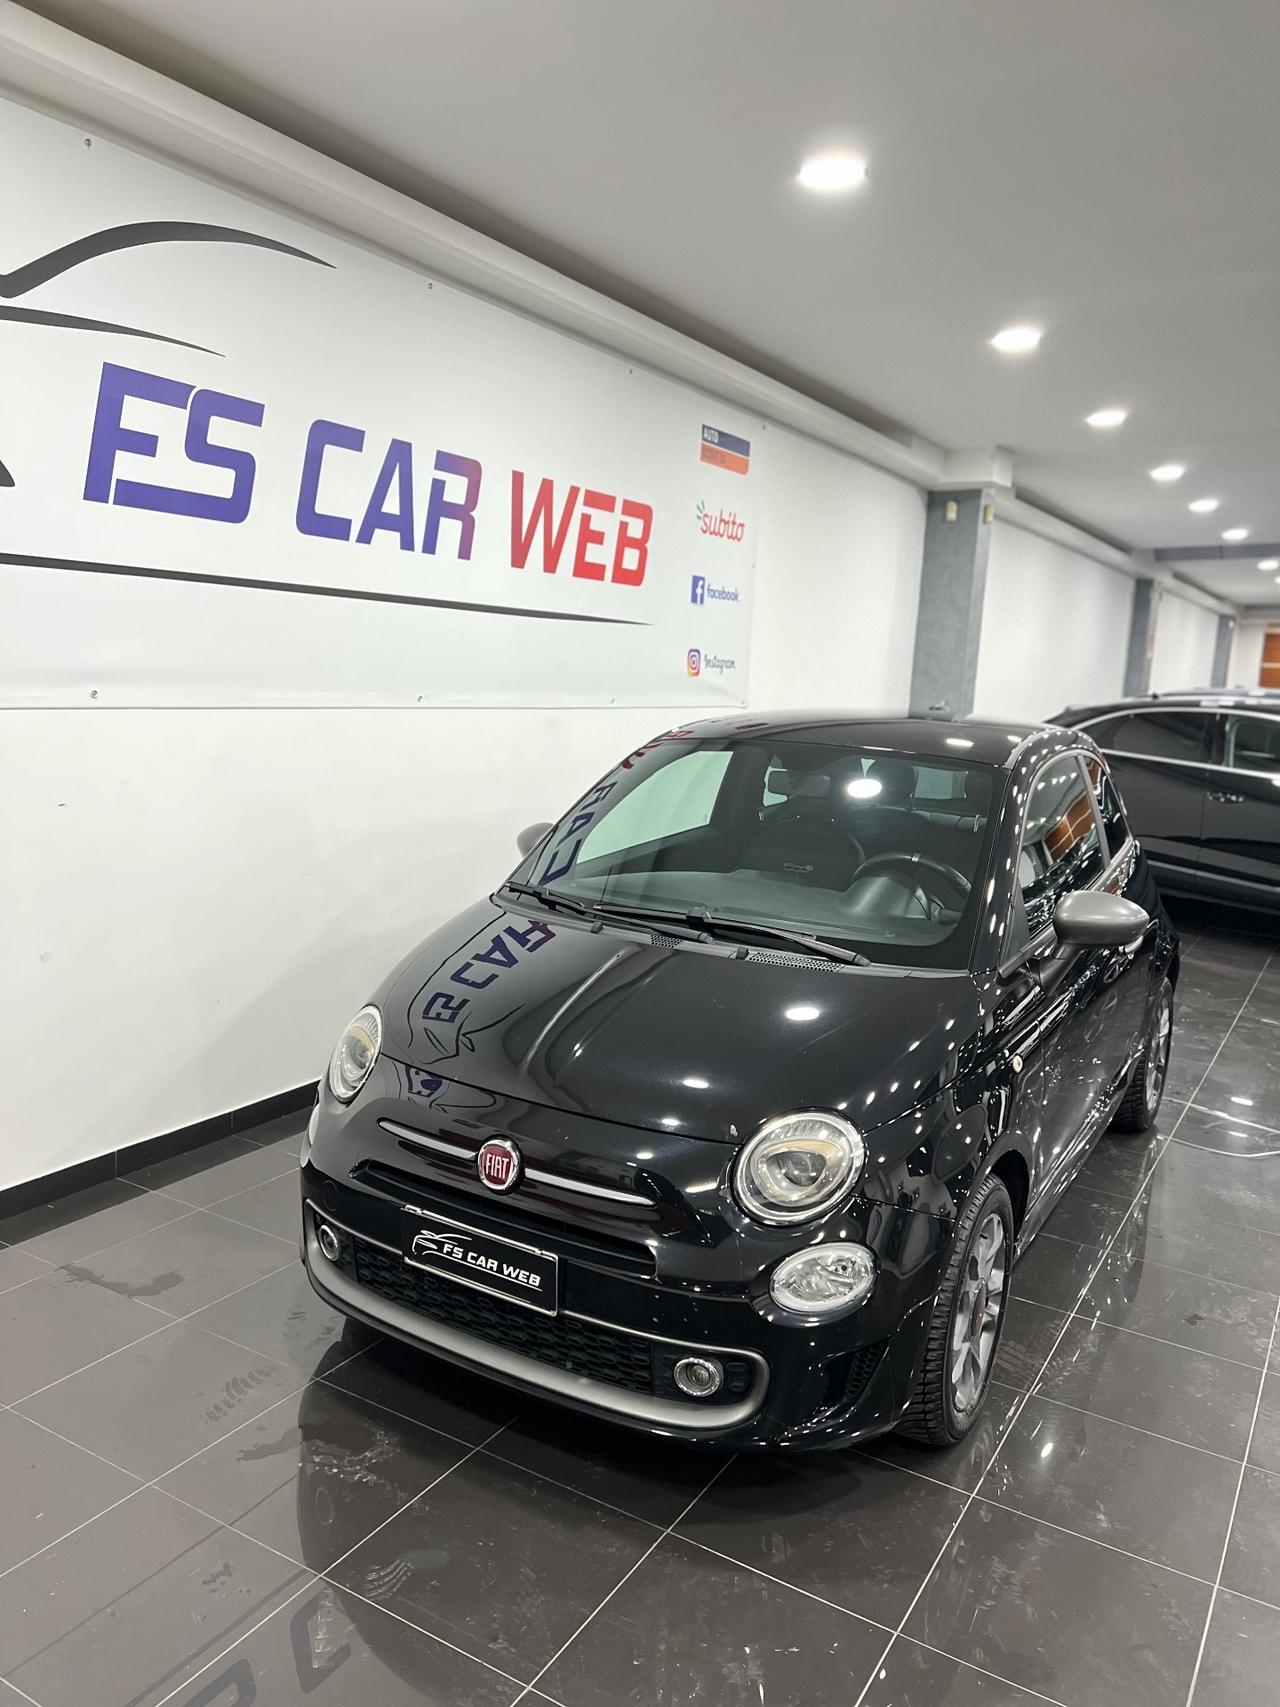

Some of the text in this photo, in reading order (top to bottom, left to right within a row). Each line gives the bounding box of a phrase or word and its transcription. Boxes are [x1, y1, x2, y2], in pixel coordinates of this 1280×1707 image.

[703, 427, 719, 443] AUTO
[295, 418, 483, 561] CAR
[510, 470, 654, 587] WEB
[701, 509, 745, 542] subito
[707, 583, 740, 602] facebook
[704, 654, 736, 674] Instagram
[486, 1153, 510, 1179] FIAT
[443, 1243, 541, 1287] FS CAR WEB
